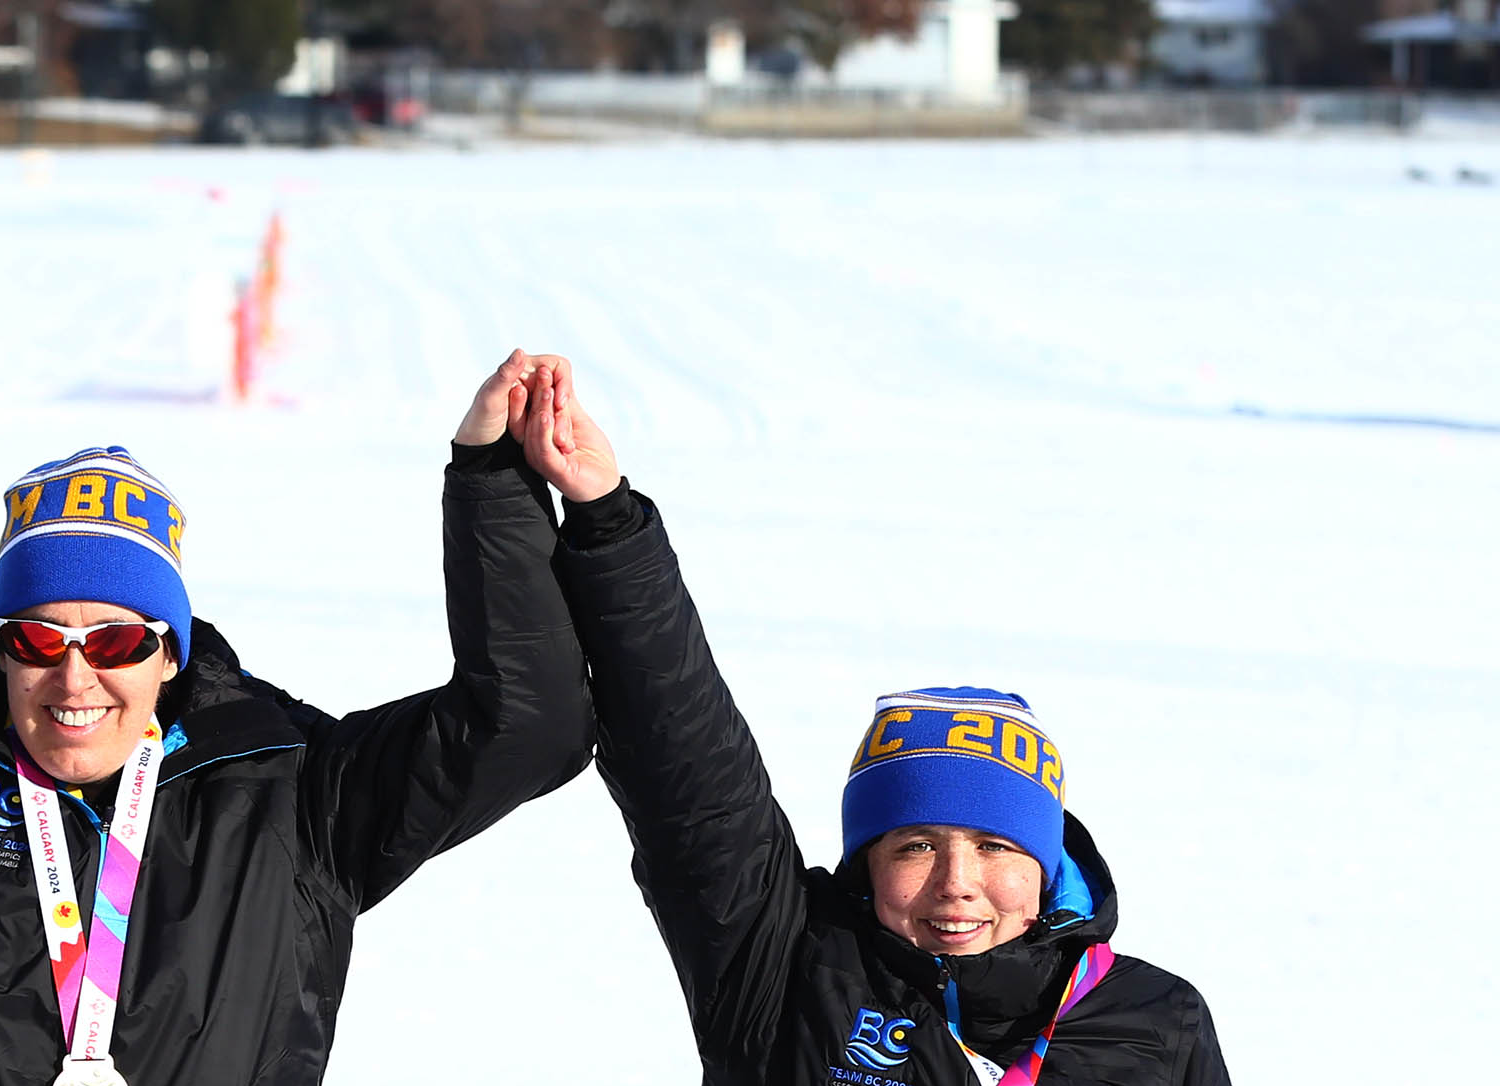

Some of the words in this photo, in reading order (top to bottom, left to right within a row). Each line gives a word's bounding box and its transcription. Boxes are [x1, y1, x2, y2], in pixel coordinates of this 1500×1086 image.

[62, 474, 149, 529] BC
[128, 769, 146, 819] CALGARY
[138, 746, 152, 767] 2024
[37, 810, 56, 863] CALGARY
[47, 867, 62, 895] 2024
[849, 1007, 917, 1054] BC
[829, 1066, 863, 1083] TEAM
[865, 1074, 882, 1086] BC
